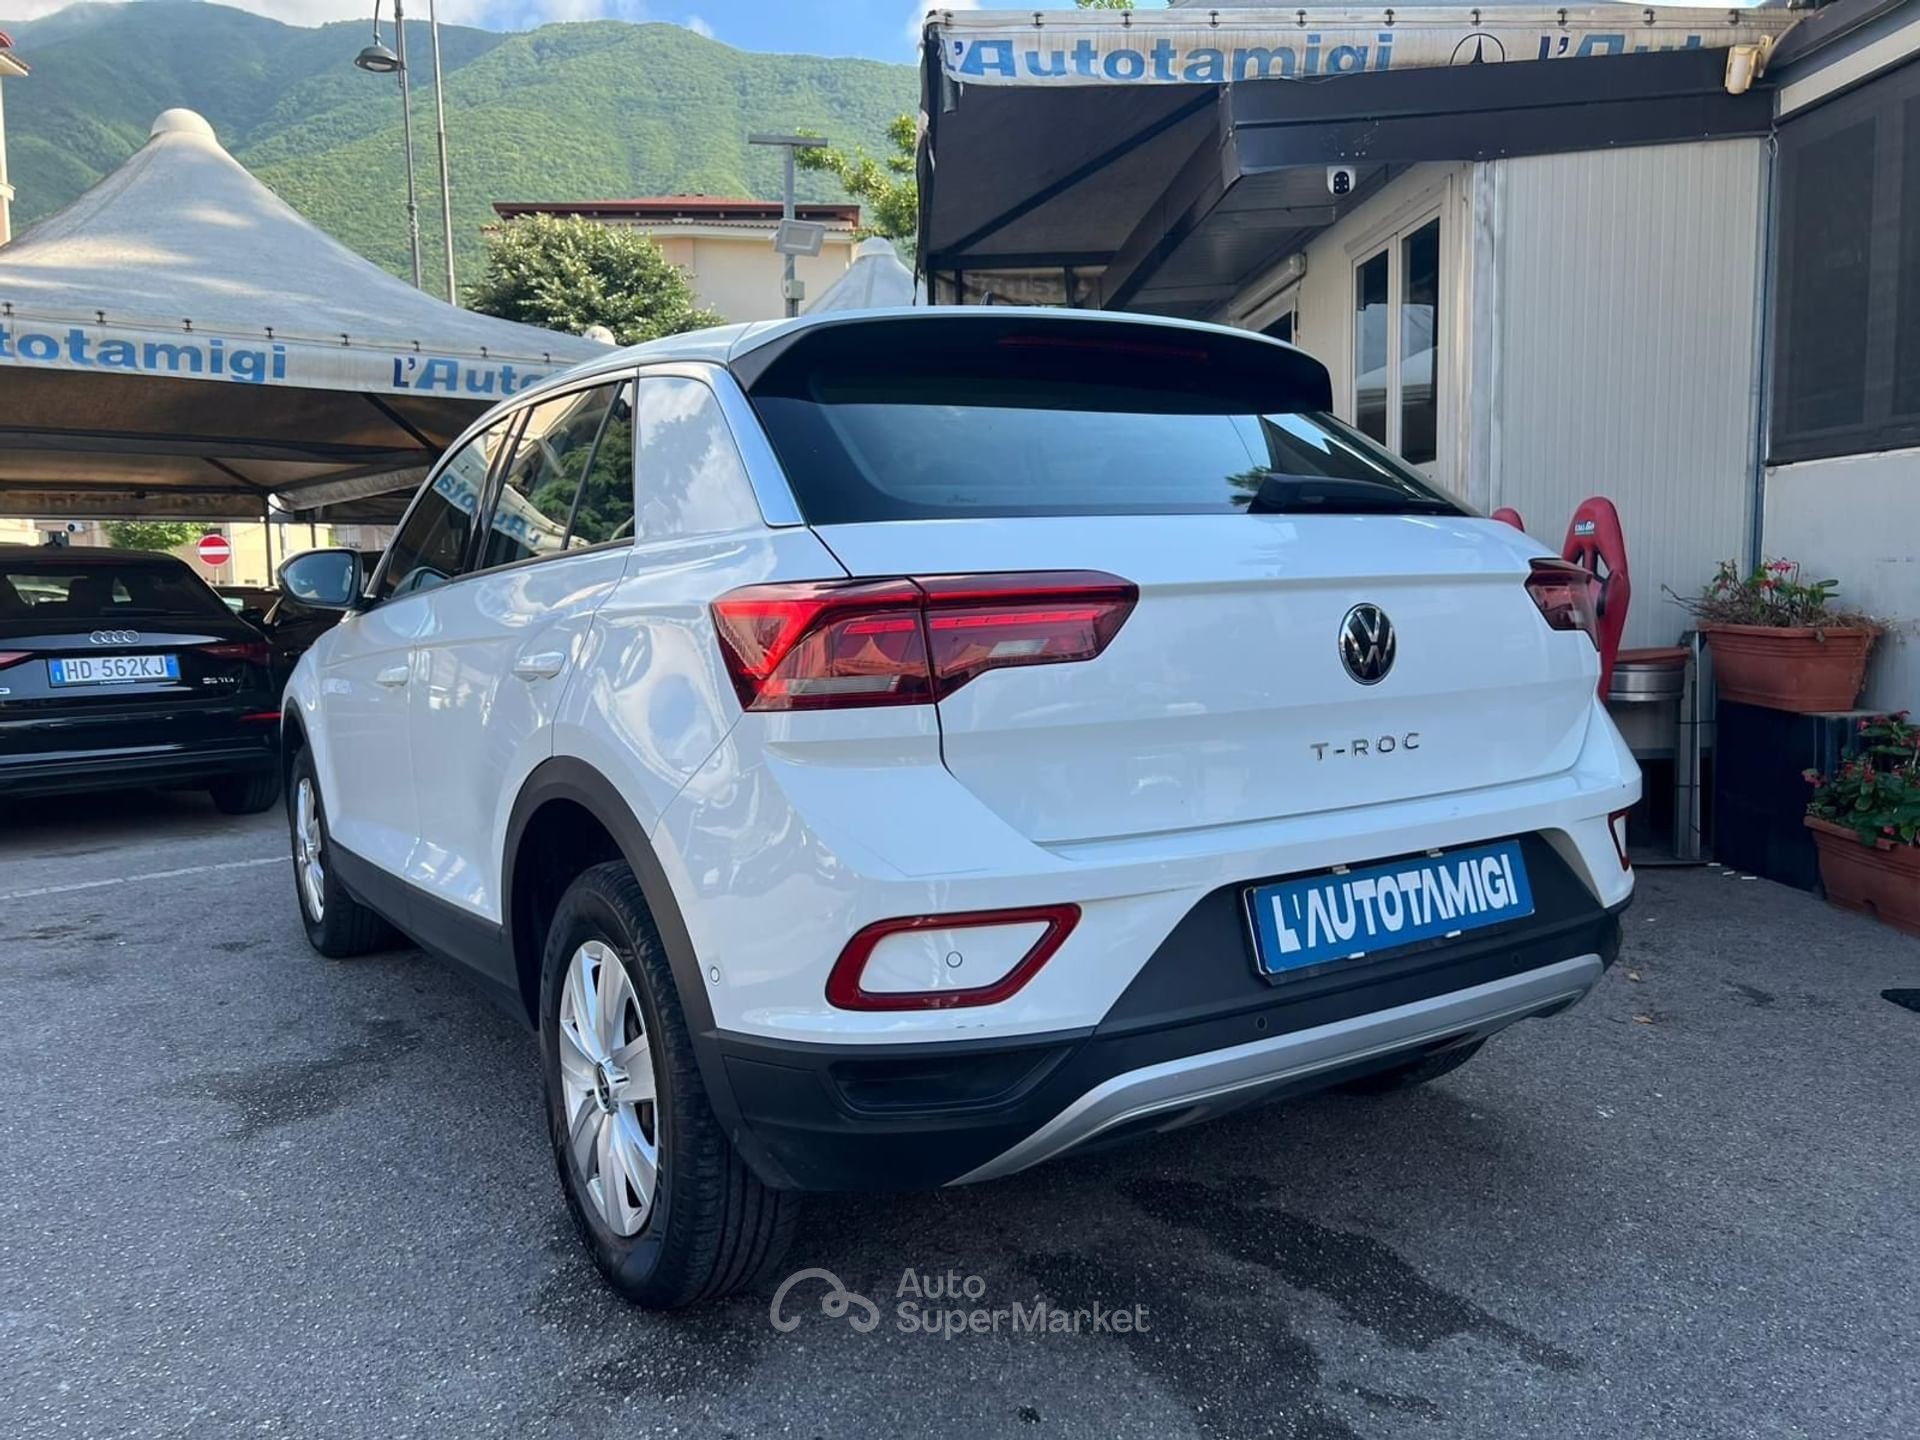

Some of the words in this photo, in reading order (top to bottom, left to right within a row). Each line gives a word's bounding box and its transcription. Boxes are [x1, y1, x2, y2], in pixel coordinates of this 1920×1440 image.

[65, 660, 92, 680] HD
[1310, 732, 1421, 761] T-ROC
[1271, 853, 1519, 954] L'AUTOTAMIGI
